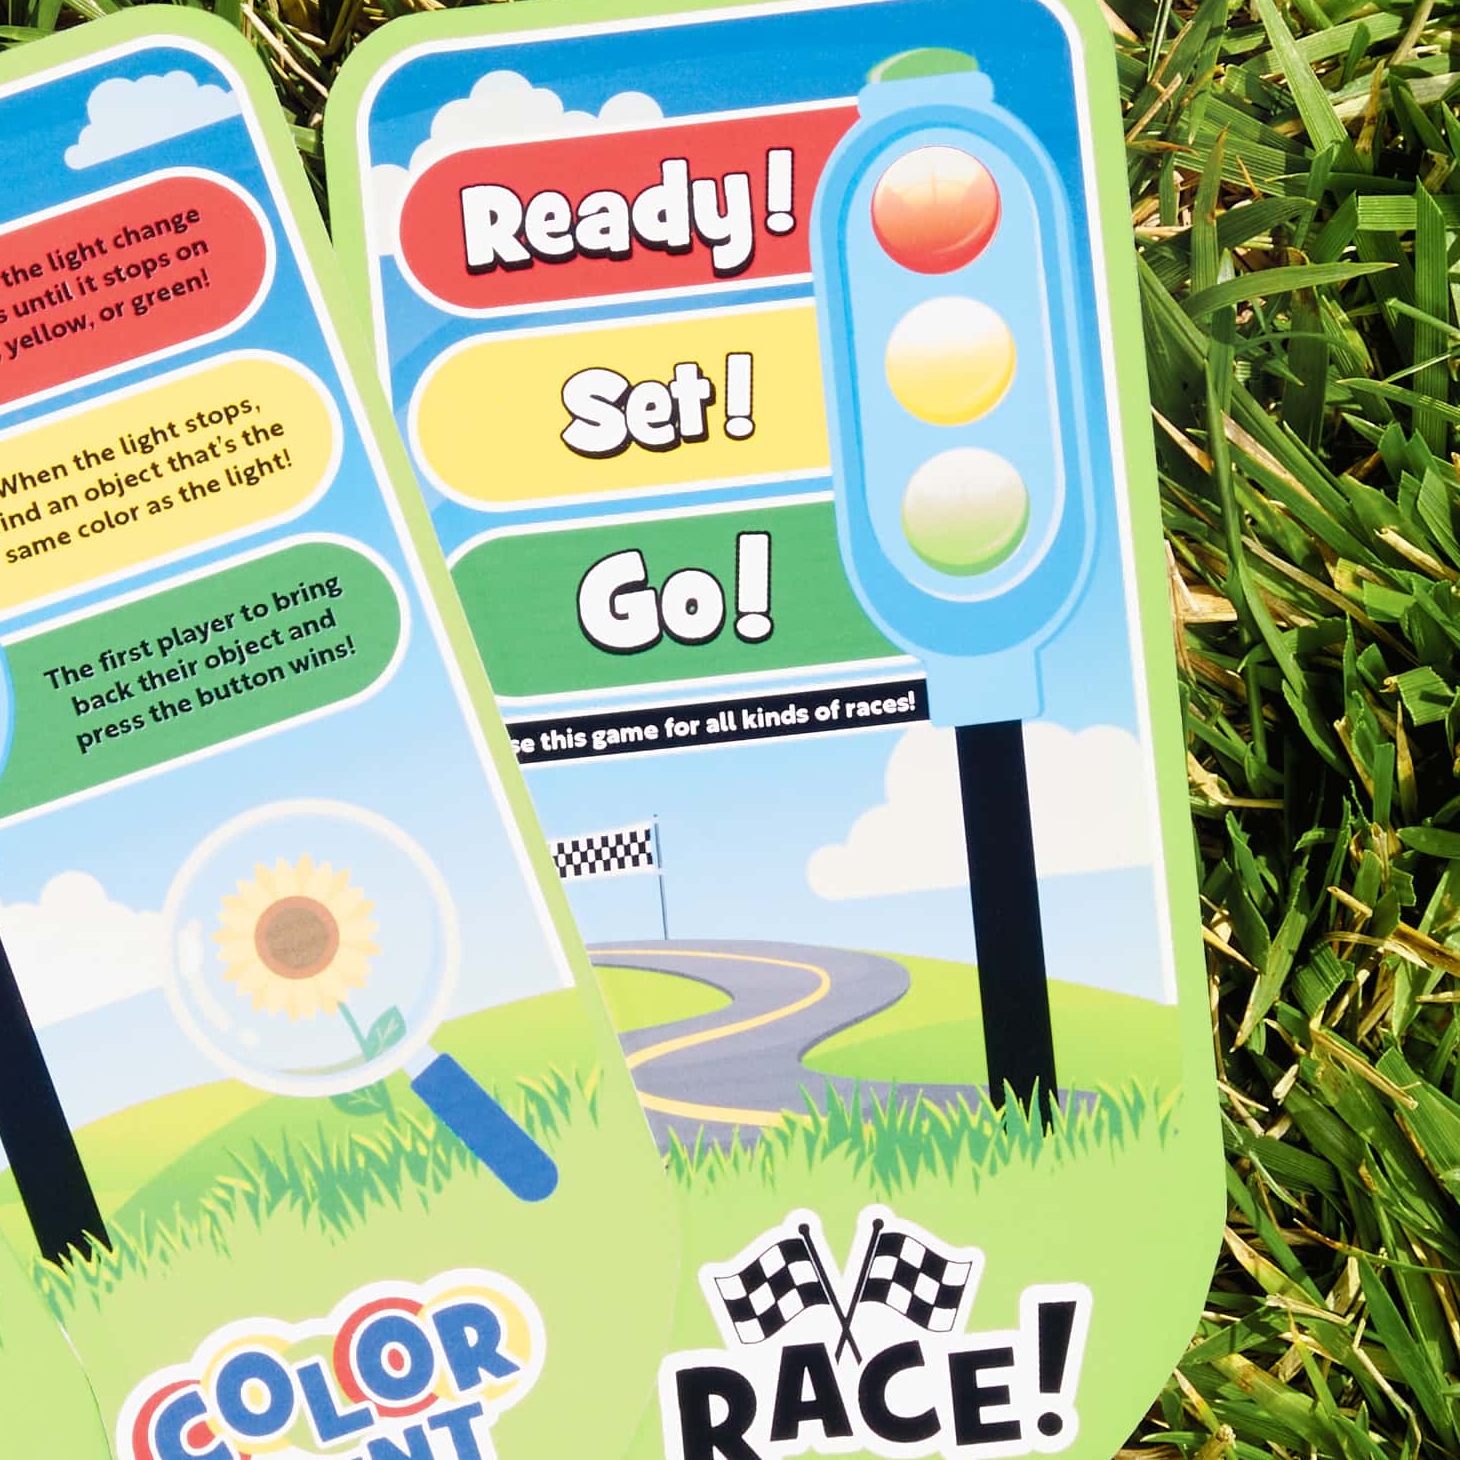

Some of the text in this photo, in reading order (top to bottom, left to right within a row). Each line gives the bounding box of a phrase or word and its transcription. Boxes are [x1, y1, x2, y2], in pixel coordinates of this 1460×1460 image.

[1, 264, 43, 287] the
[48, 239, 107, 271] light
[114, 210, 200, 248] change
[459, 147, 797, 279] Ready!
[5, 315, 94, 359] yellow,
[100, 302, 124, 321] or
[132, 268, 209, 316] green!
[13, 282, 73, 317] until
[77, 276, 98, 295] it
[104, 254, 170, 286] stops
[176, 241, 208, 260] on
[73, 448, 115, 470] the
[120, 423, 180, 455] light
[186, 400, 260, 432] stops,
[560, 351, 756, 460] Set!
[6, 449, 291, 563] same color as the light!
[48, 495, 78, 514] an
[85, 463, 163, 501] object
[168, 436, 236, 472] that's
[242, 424, 284, 446] the
[44, 577, 342, 689] The first player to bring
[576, 530, 774, 655] Go!
[72, 608, 336, 716] back their object and
[76, 636, 355, 754] press the button wins!
[510, 691, 915, 754] se this game for all kinds of races!
